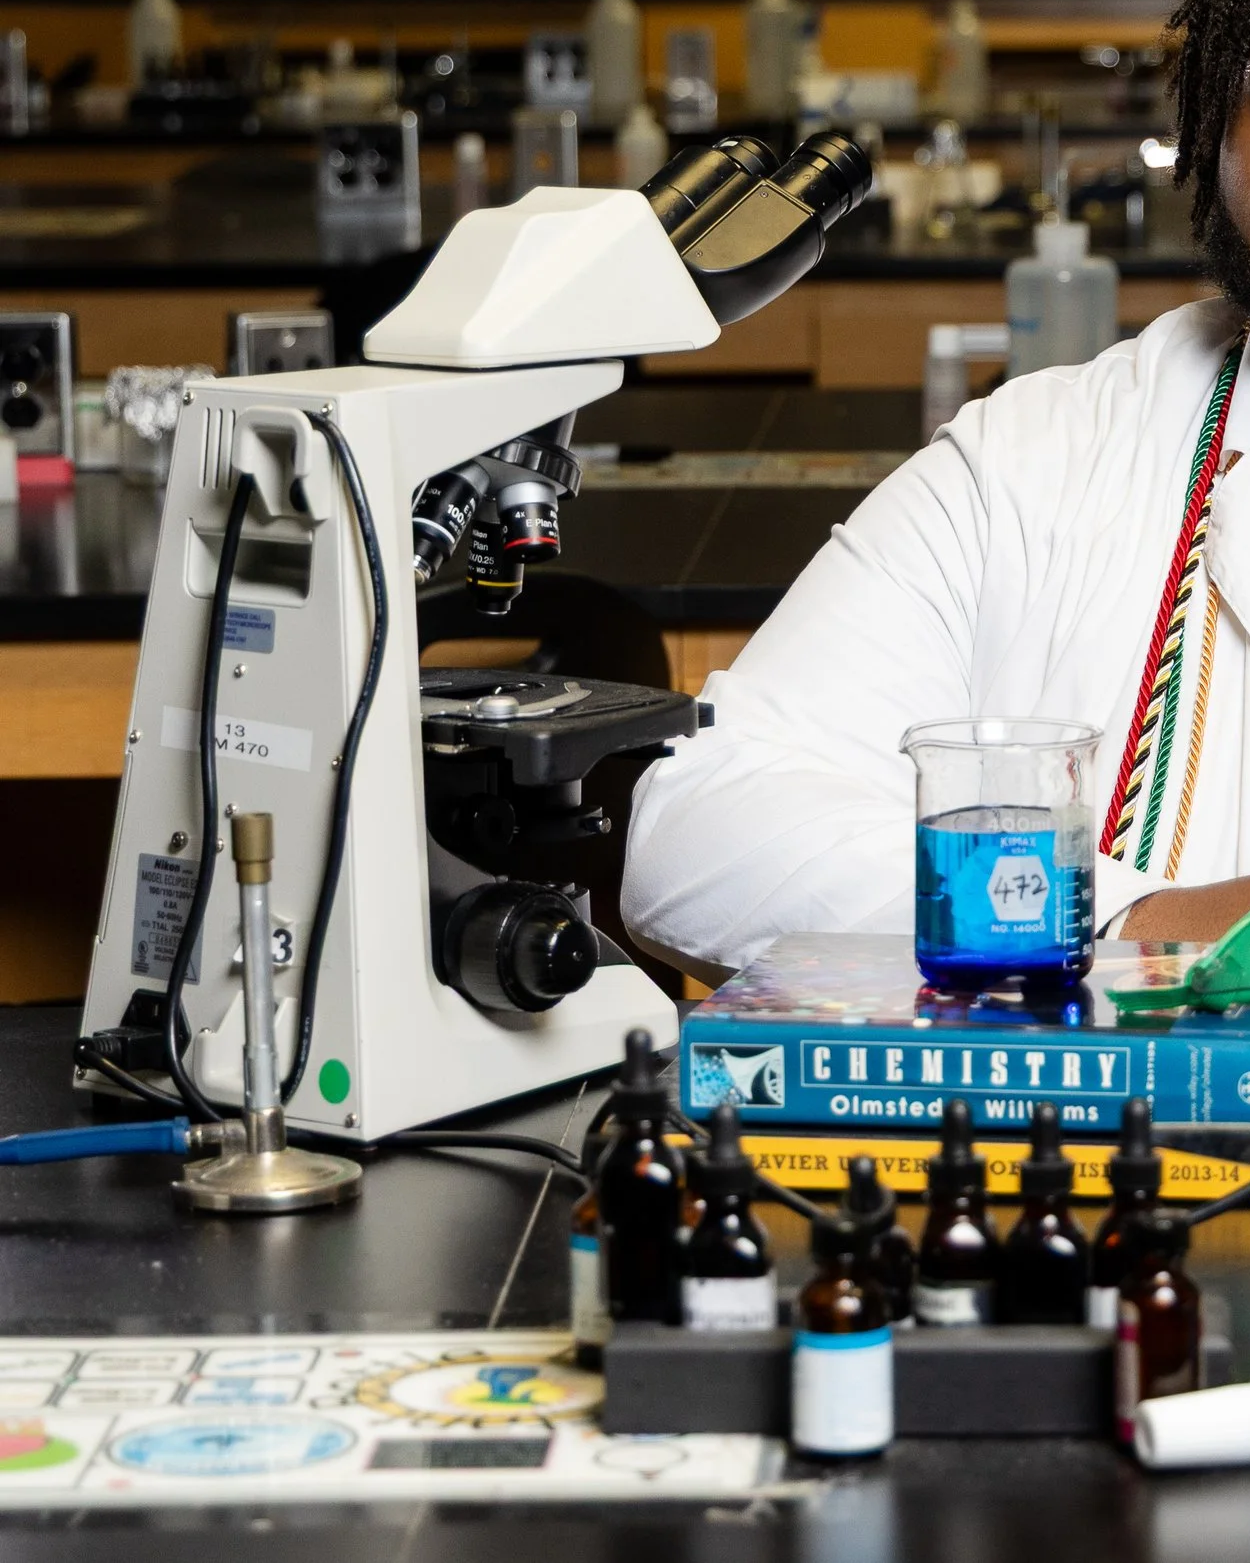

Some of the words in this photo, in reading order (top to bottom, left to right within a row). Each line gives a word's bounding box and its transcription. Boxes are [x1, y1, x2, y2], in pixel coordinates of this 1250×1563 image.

[535, 518, 553, 528] Plan
[225, 724, 246, 738] 13
[235, 742, 270, 758] 470
[154, 859, 181, 873] Nikon
[994, 872, 1048, 905] 472
[813, 1046, 1117, 1088] CHEMISTRY
[830, 1094, 944, 1118] Olmsted
[984, 1098, 1099, 1122] Willms
[756, 1153, 829, 1172] AVIER
[1169, 1165, 1240, 1182] 2013-14
